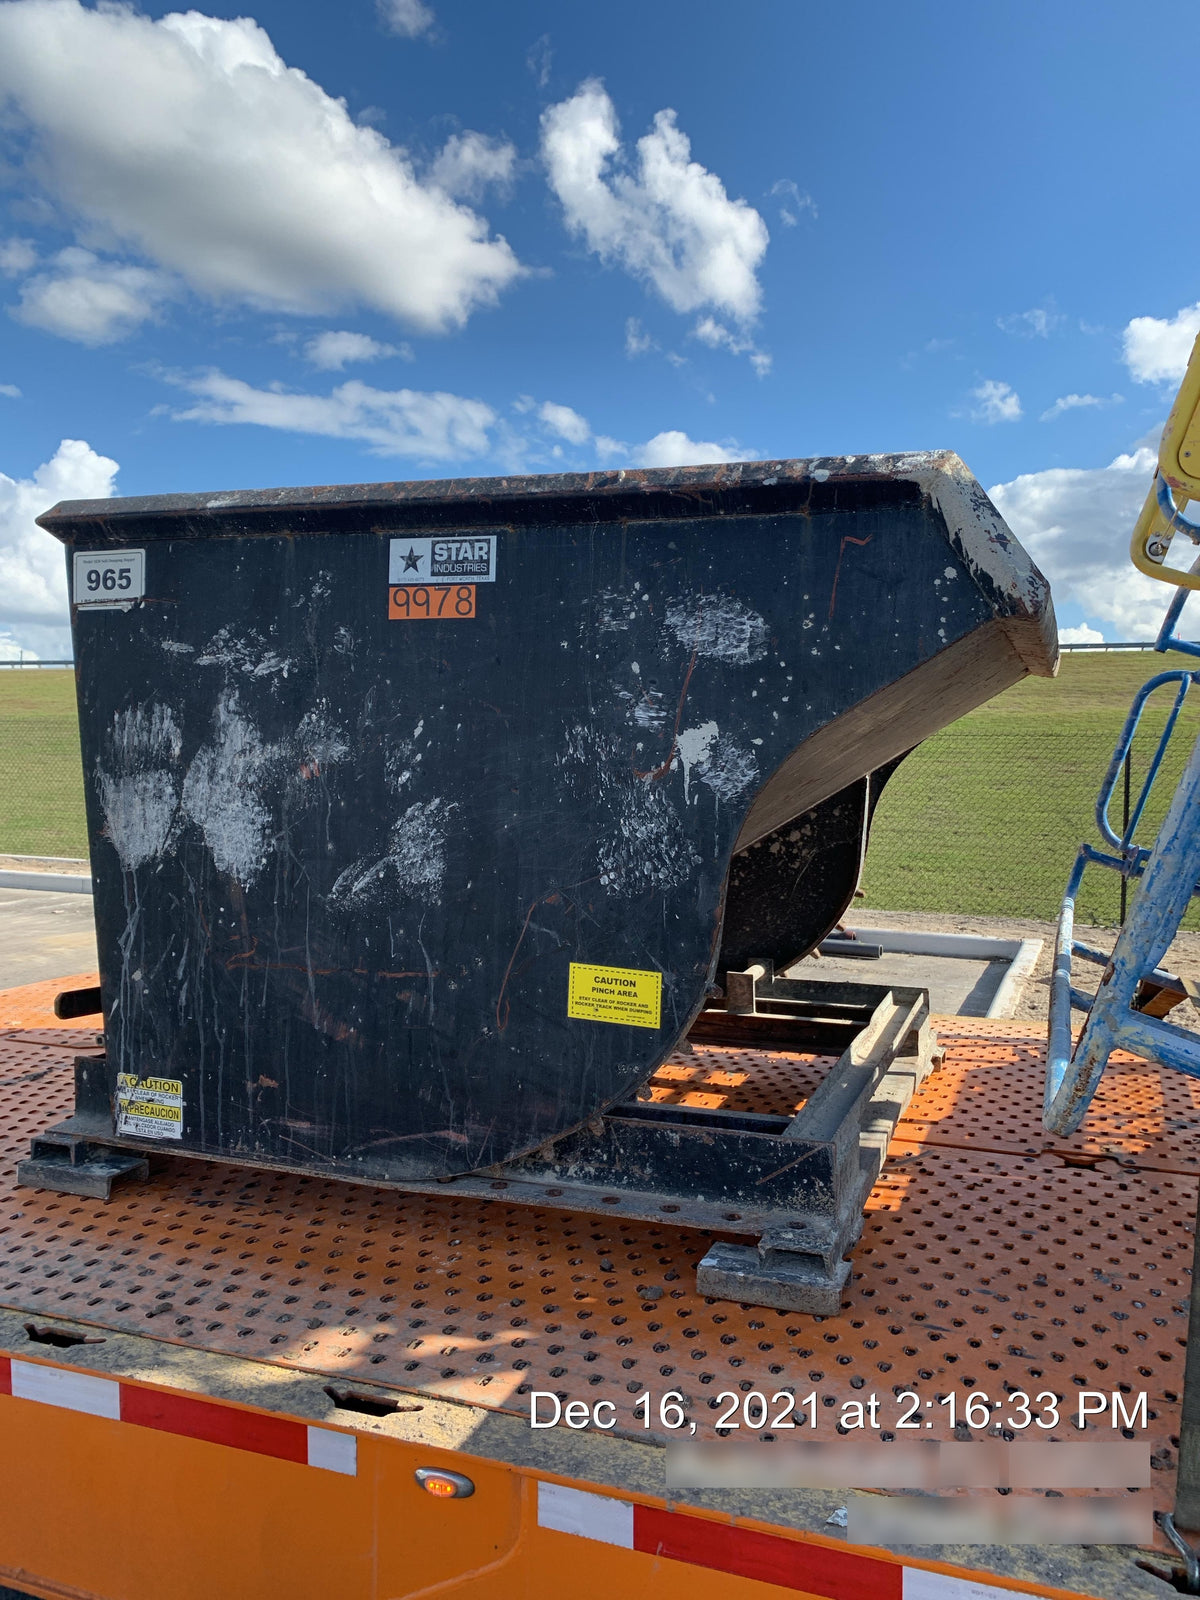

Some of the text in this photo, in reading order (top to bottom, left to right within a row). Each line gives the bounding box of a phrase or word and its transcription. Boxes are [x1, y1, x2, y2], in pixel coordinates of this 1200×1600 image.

[434, 542, 488, 561] STAR
[433, 562, 487, 573] INDUSTRIES
[86, 568, 131, 591] 965
[393, 586, 473, 616] 9978
[594, 976, 636, 987] CAUTION
[592, 987, 638, 998] PINCH AREA
[575, 1000, 595, 1008] ROCKER
[629, 1006, 653, 1015] DUMPING
